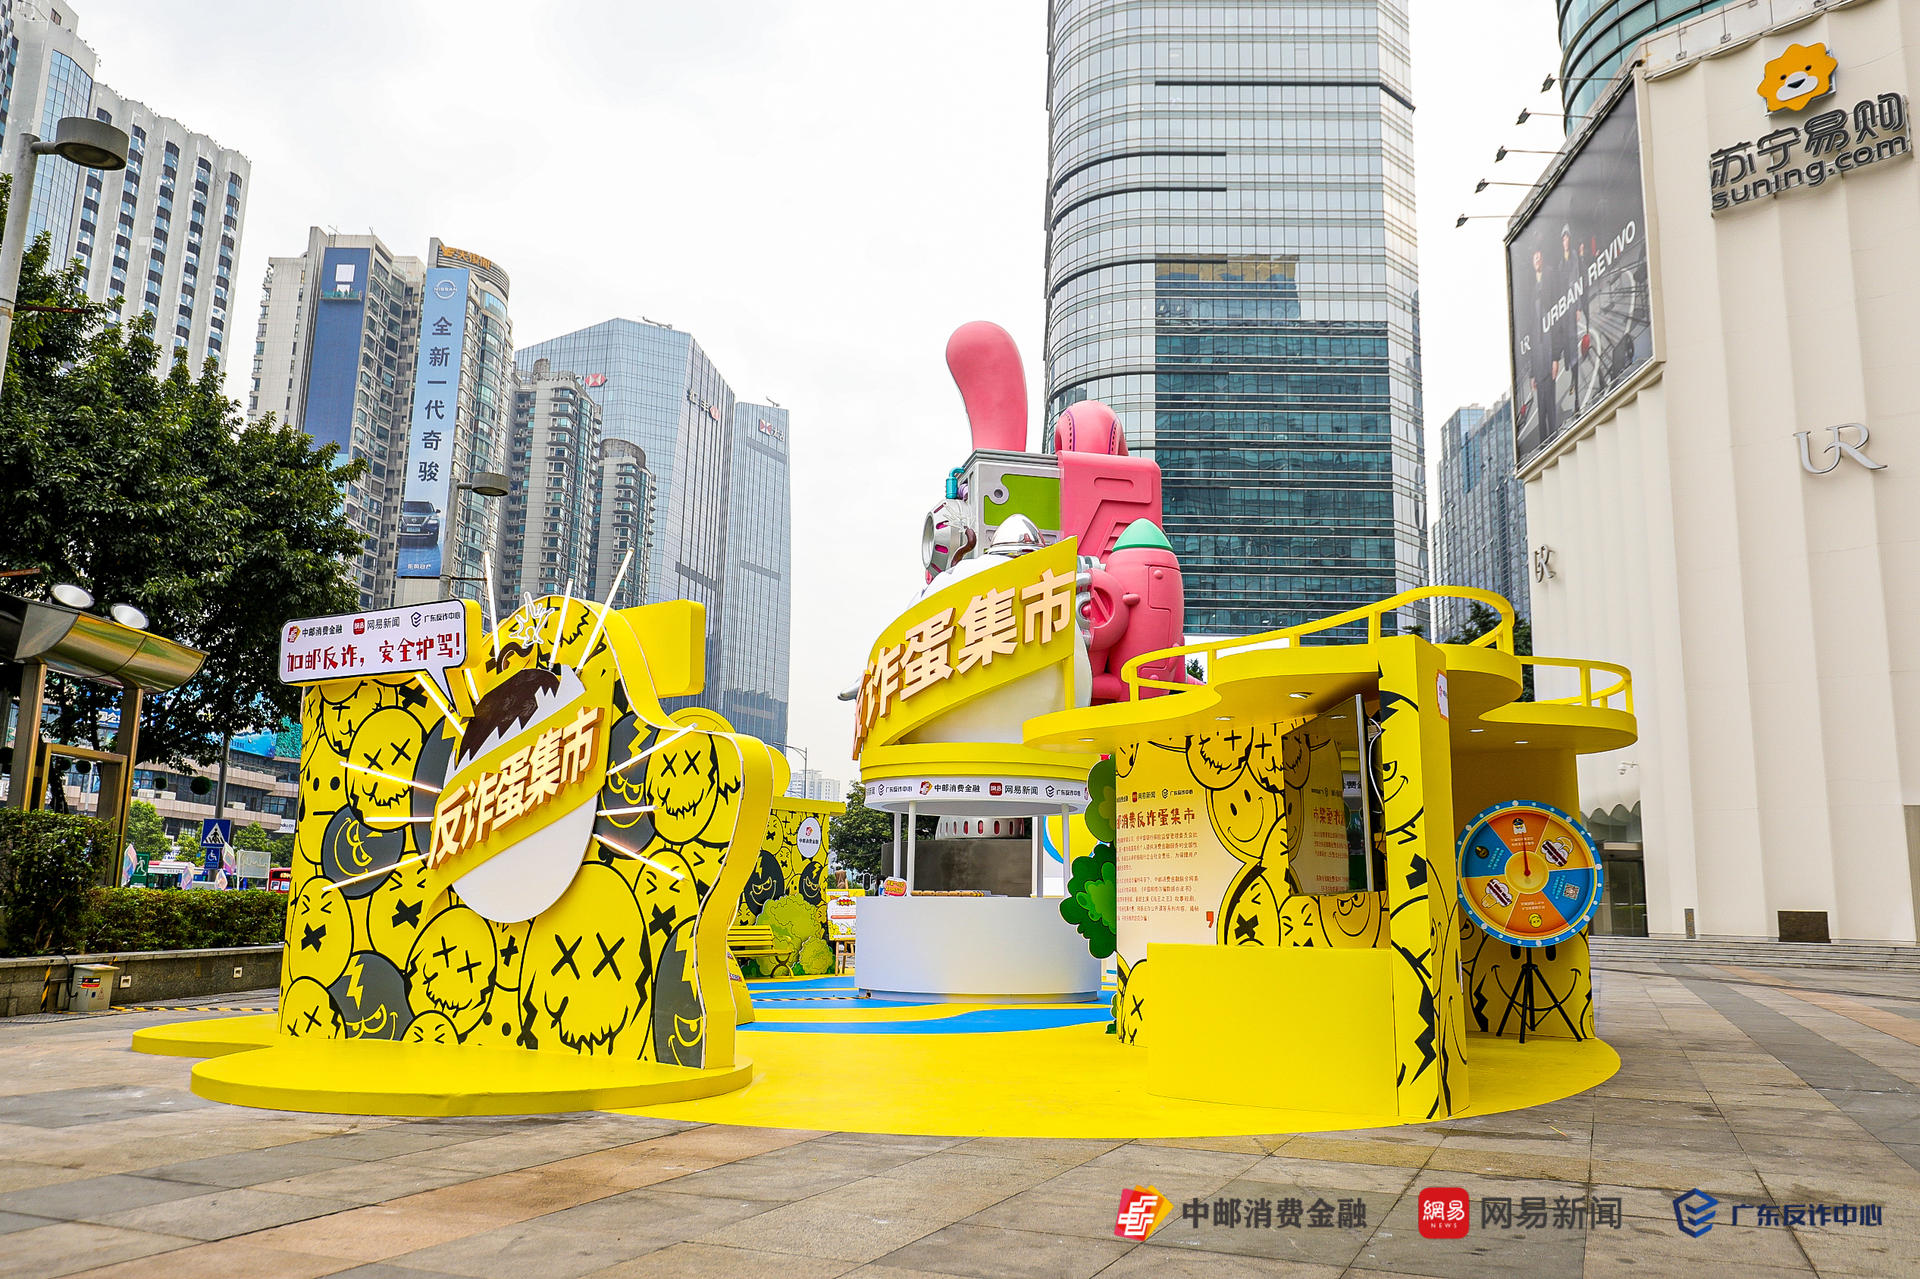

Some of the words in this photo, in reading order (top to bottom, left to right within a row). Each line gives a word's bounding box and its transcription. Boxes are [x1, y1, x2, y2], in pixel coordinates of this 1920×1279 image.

[1711, 92, 1907, 188] 苏宁易购
[1712, 136, 1909, 210] suning.com
[1542, 276, 1584, 334] URBAN
[1587, 220, 1636, 287] REVIVO
[418, 316, 452, 482] 全新一代奇骏
[1793, 422, 1888, 475] UR
[301, 624, 343, 638] 中邮消费金融
[367, 616, 401, 632] 网易新闻
[424, 611, 461, 623] 广东反诈中心
[427, 706, 605, 870] 反诈蛋集市
[934, 783, 981, 793] 中邮消费金融
[1004, 784, 1038, 796] 网易新闻
